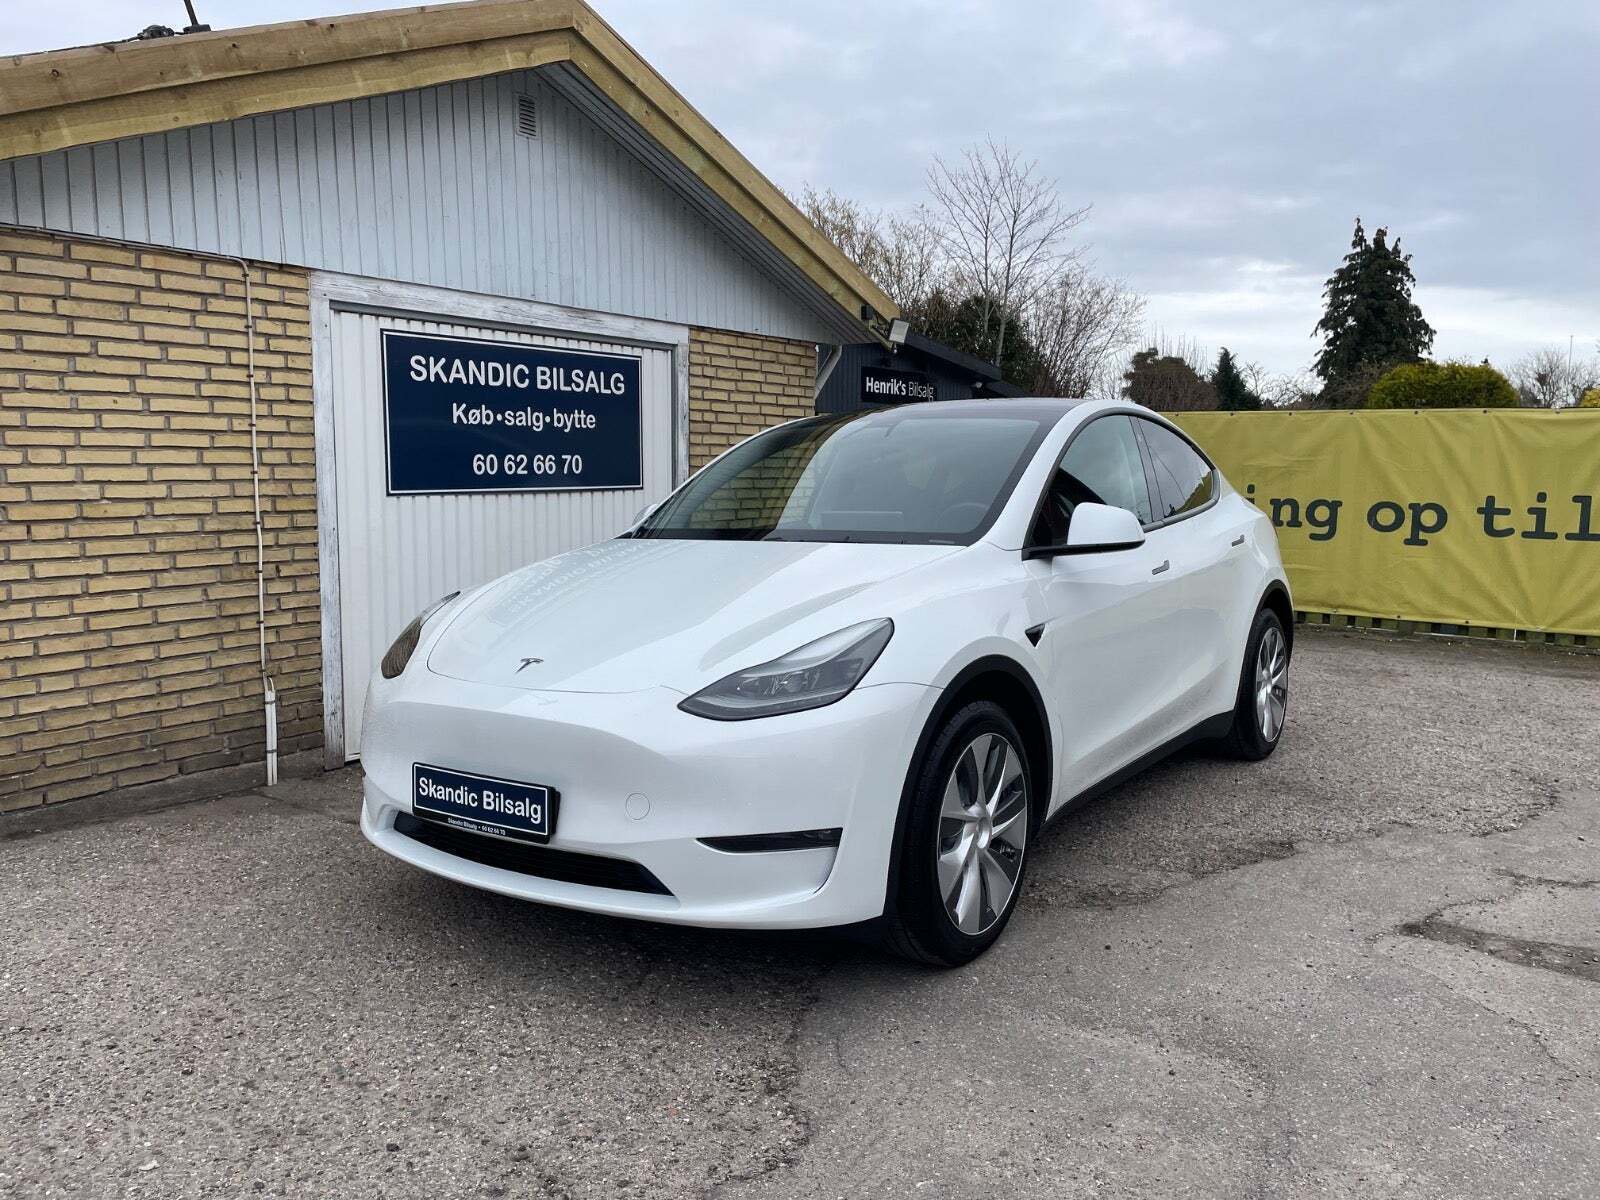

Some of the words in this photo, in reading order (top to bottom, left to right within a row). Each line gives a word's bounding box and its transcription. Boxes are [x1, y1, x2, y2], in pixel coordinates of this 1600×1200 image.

[409, 355, 530, 389] SKANDIC
[536, 366, 625, 395] BILSALG
[866, 377, 906, 396] Henrik's
[908, 381, 934, 401] Bilsalg
[472, 454, 498, 475] 60
[503, 454, 528, 475] 62
[533, 454, 556, 475] 66
[561, 454, 583, 475] 70
[1244, 484, 1343, 541] ng
[1367, 501, 1448, 546] op
[418, 776, 478, 807] Skandic
[482, 790, 542, 824] Bilsalg
